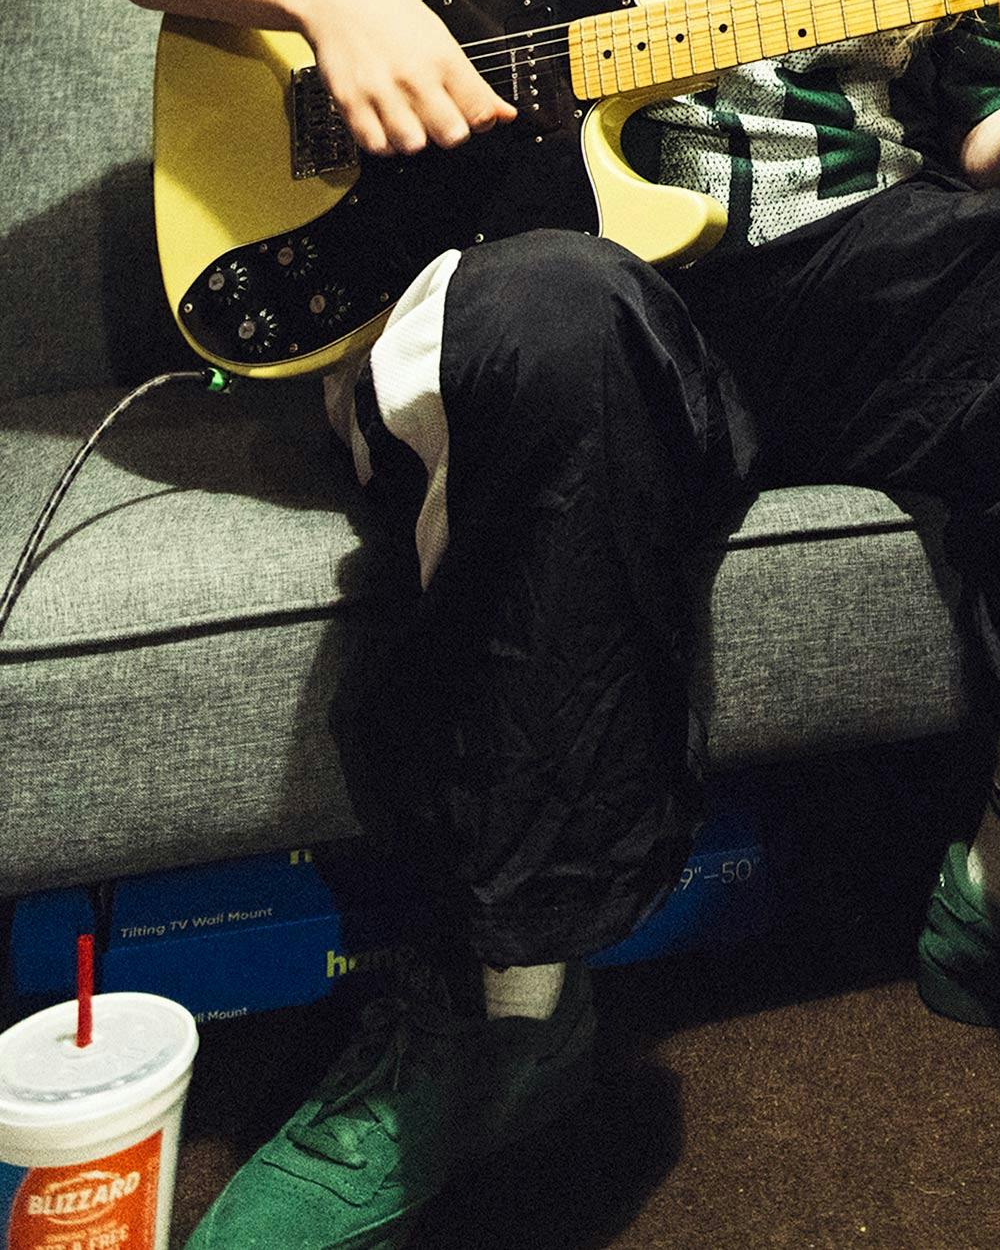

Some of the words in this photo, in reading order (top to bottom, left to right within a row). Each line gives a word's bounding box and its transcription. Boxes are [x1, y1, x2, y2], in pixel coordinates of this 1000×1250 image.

[121, 924, 166, 938] Tilting
[170, 918, 188, 930] TV
[192, 912, 224, 927] Wall
[228, 907, 273, 922] Mount
[208, 1006, 248, 1022] Mount
[27, 1171, 141, 1215] BLIZZARD
